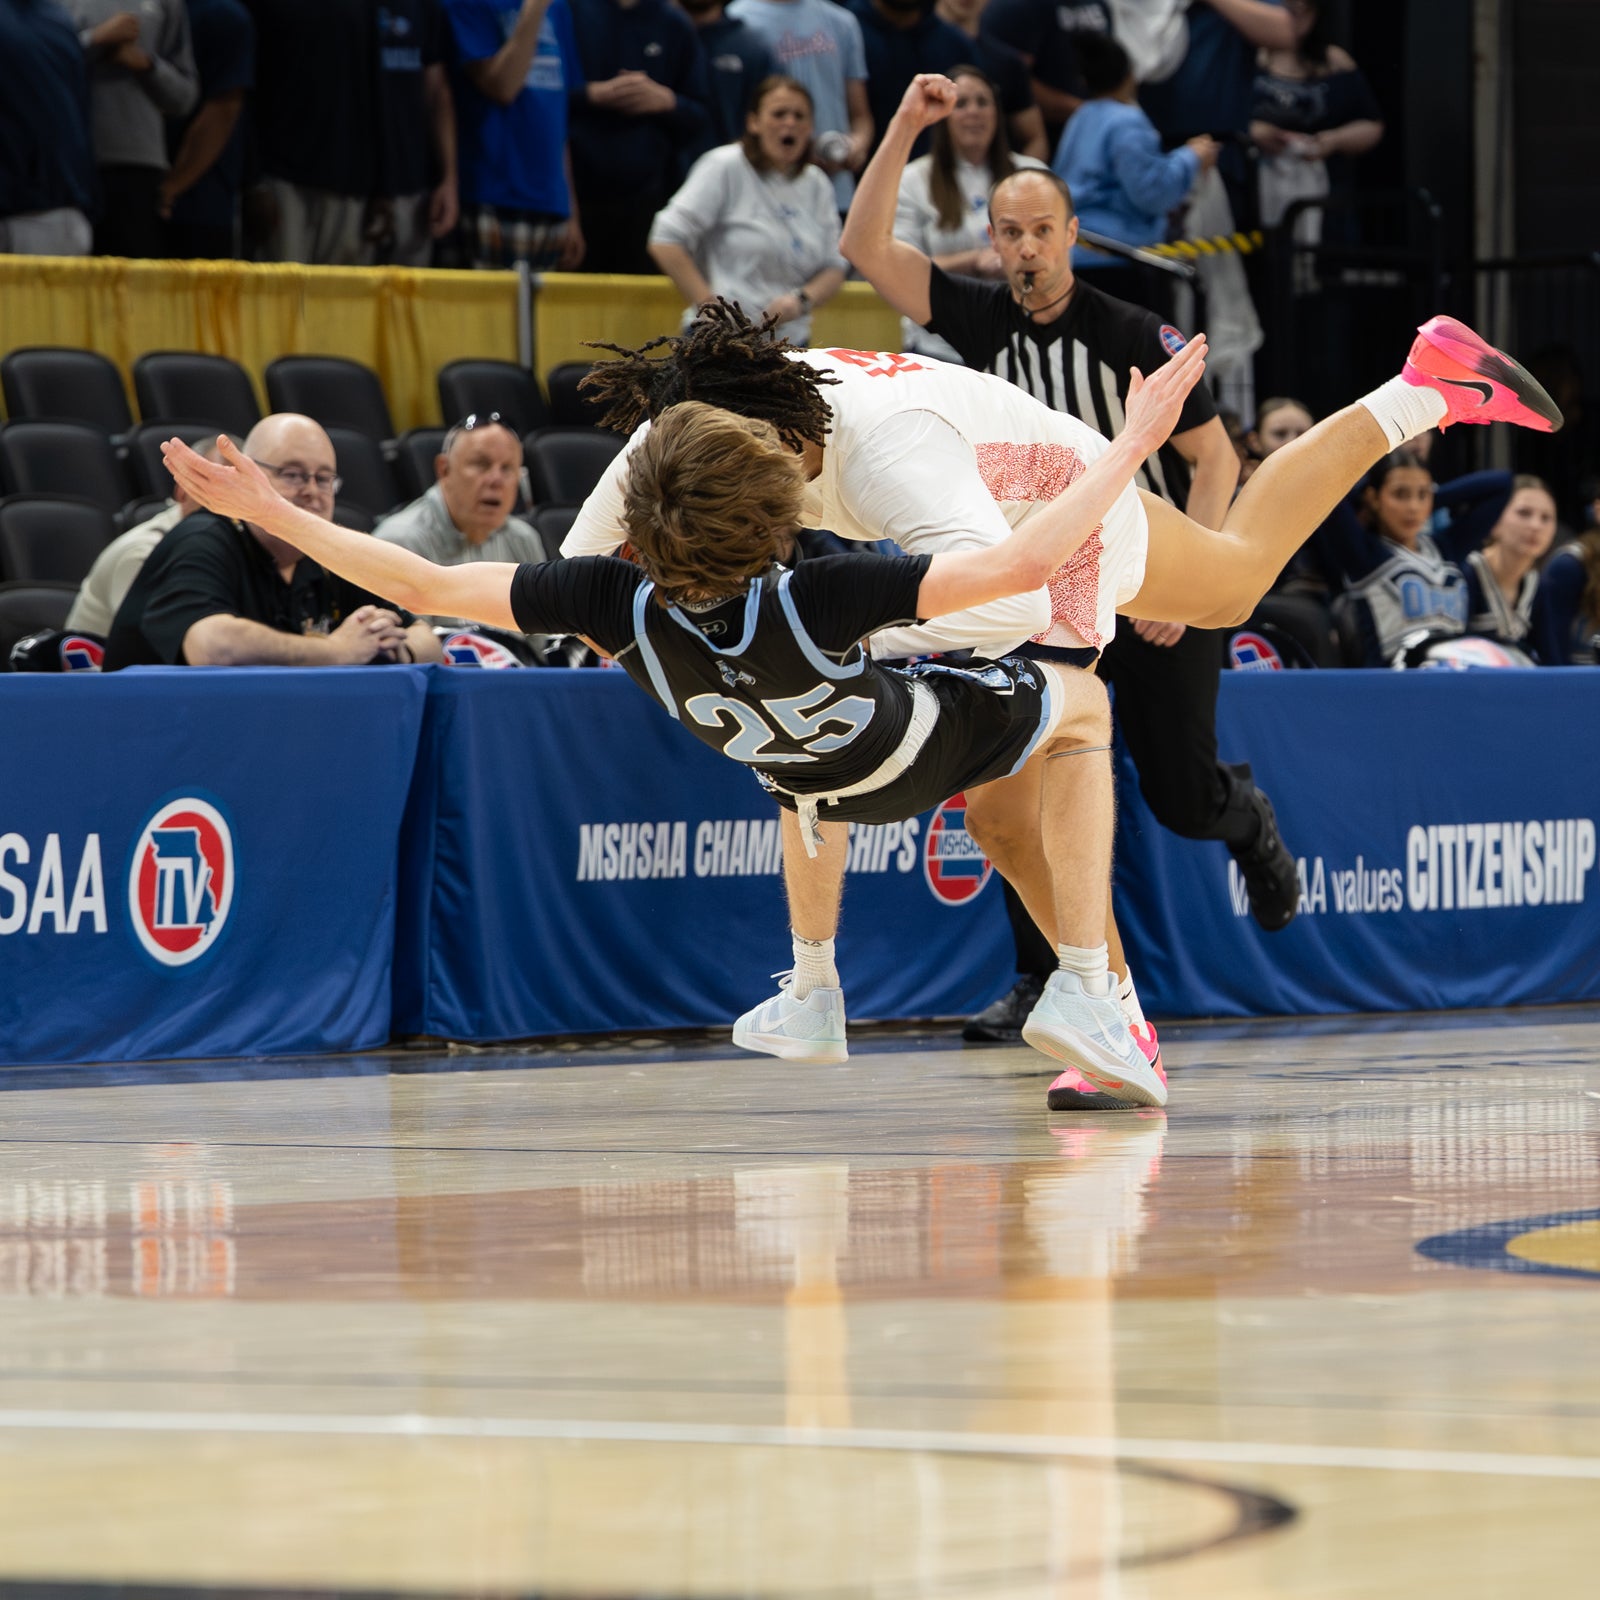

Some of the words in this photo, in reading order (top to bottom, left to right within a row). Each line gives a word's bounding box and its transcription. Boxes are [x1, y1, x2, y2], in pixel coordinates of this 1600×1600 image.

[685, 682, 875, 763] 25
[576, 821, 688, 881] MSHSAA
[694, 816, 920, 876] CHAMHIPS
[938, 832, 982, 856] MSHSA
[1228, 856, 1327, 917] MAA
[1331, 855, 1404, 914] values
[1407, 818, 1597, 912] CITIZENSHIP
[0, 832, 108, 935] SAA
[155, 857, 208, 926] TV
